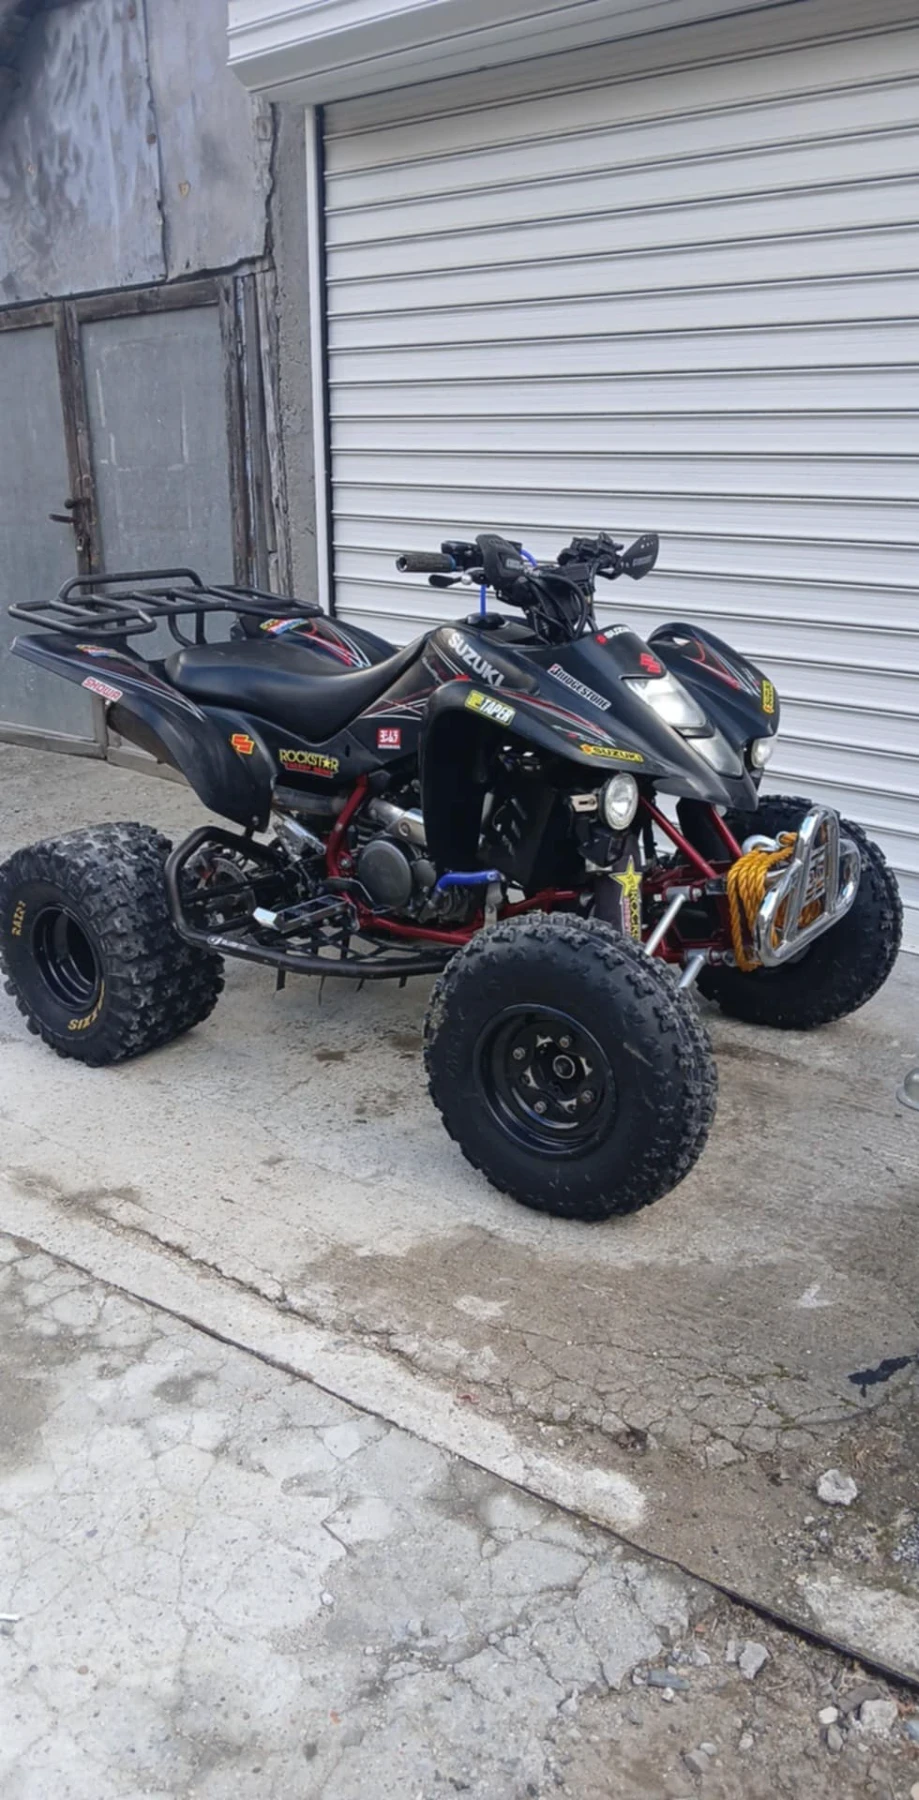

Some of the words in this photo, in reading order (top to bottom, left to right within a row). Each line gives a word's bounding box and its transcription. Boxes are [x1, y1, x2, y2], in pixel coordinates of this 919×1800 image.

[448, 632, 505, 687] SUZUKI
[84, 678, 121, 699] SHOWA
[550, 664, 609, 709] BRIDGESTONE
[480, 698, 516, 722] TAPER
[68, 979, 105, 1031] XXIS
